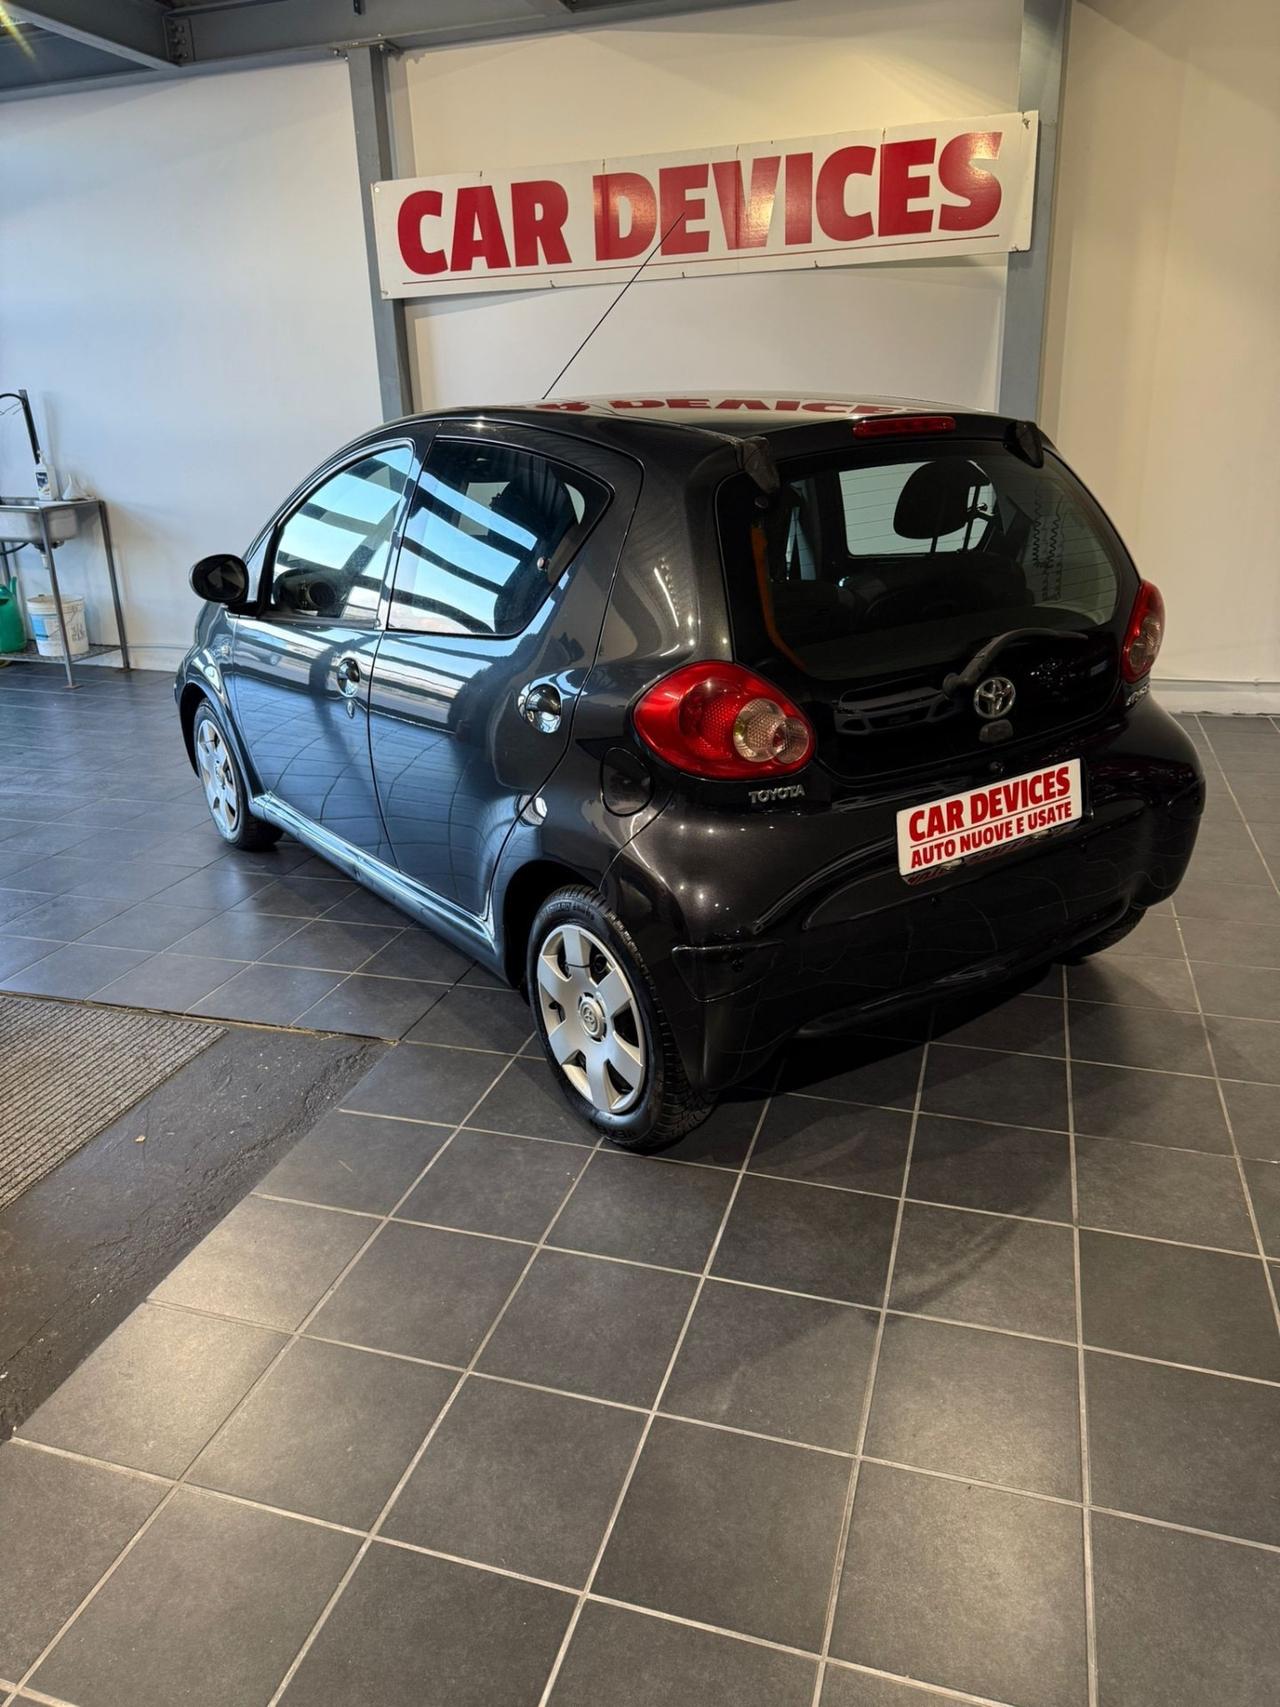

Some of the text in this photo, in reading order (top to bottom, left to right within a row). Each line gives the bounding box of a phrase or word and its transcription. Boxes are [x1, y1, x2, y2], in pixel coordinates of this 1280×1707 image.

[397, 131, 1003, 276] CAR DEVICES
[748, 784, 806, 804] TOYOTA
[909, 766, 1071, 842] CAR DEVICES
[911, 801, 1072, 869] AUTO NUOVE E USATE
